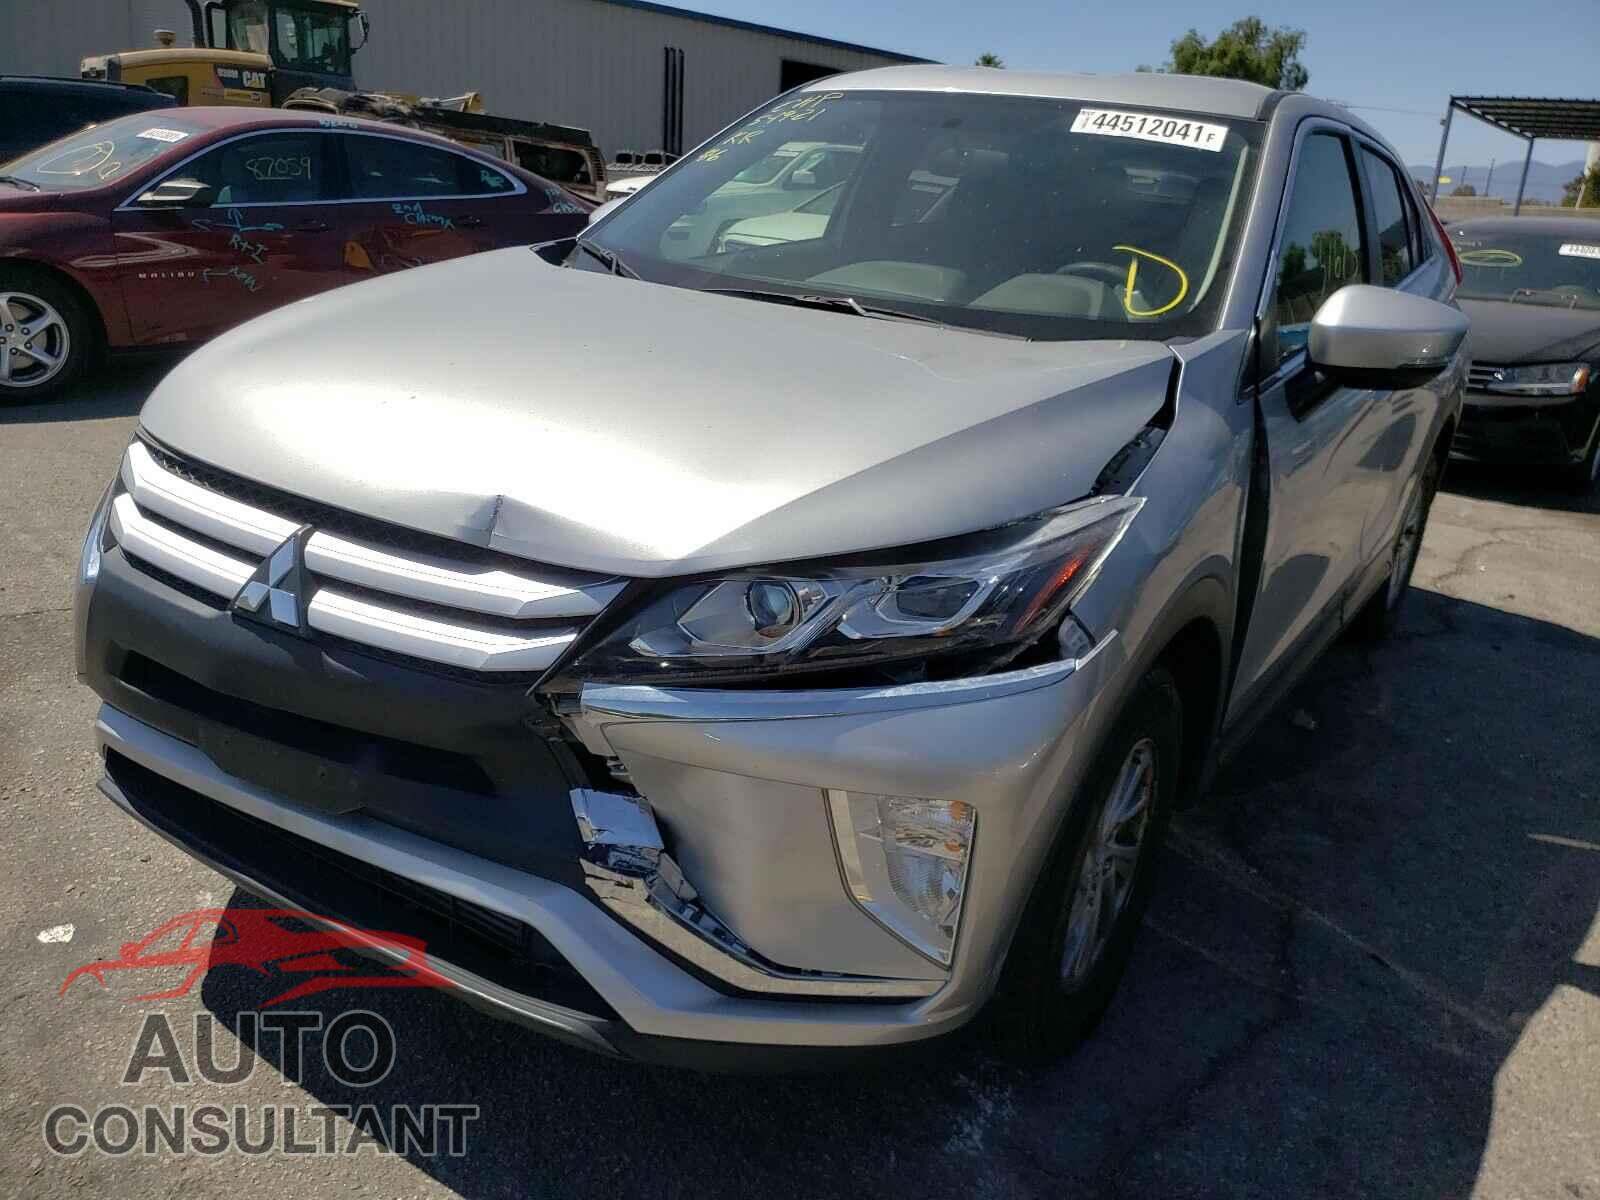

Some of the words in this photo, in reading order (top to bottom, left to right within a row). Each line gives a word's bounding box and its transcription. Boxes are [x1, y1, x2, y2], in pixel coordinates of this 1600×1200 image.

[242, 71, 266, 88] CAT
[1093, 113, 1204, 142] 44512041
[1111, 245, 1189, 317] D
